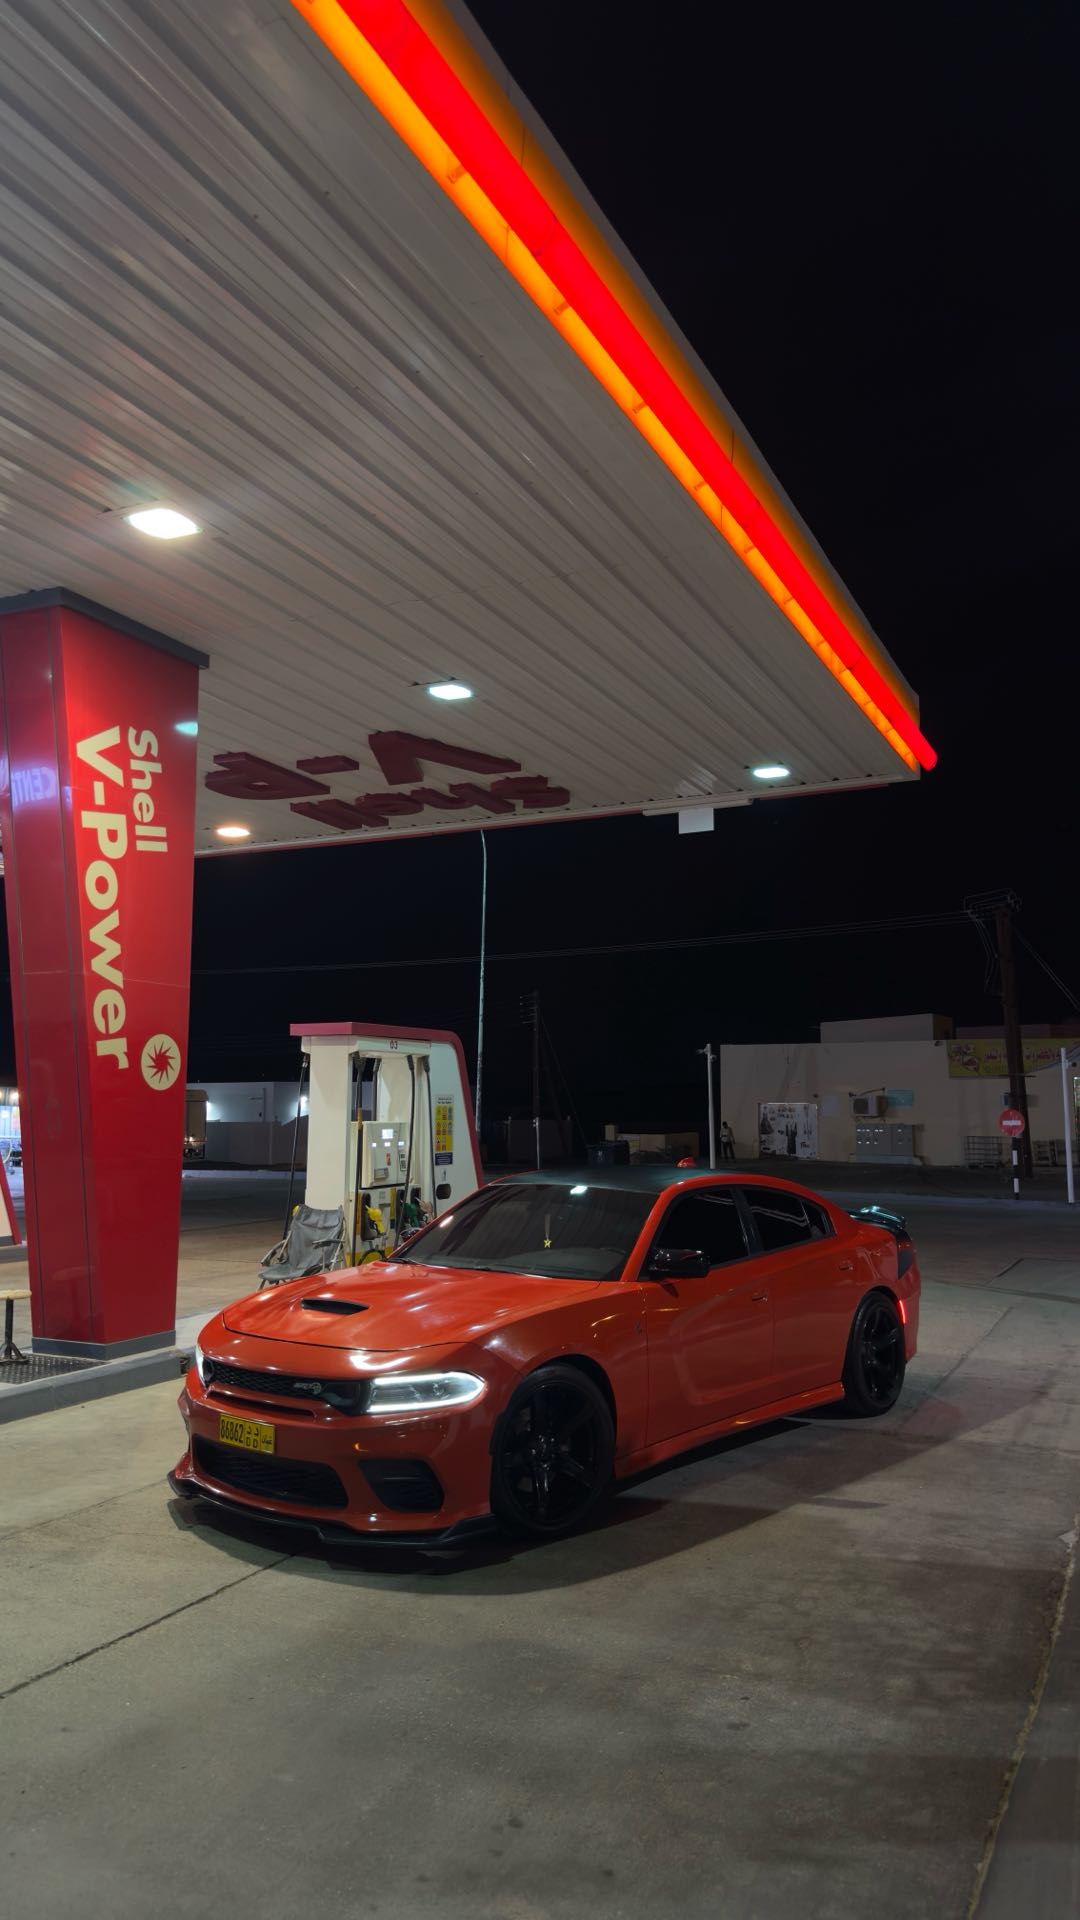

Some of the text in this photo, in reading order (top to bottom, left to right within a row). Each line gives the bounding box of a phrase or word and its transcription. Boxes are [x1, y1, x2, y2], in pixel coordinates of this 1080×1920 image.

[128, 726, 168, 852] Shell
[290, 775, 570, 829] Shell
[76, 725, 129, 1069] V-Power
